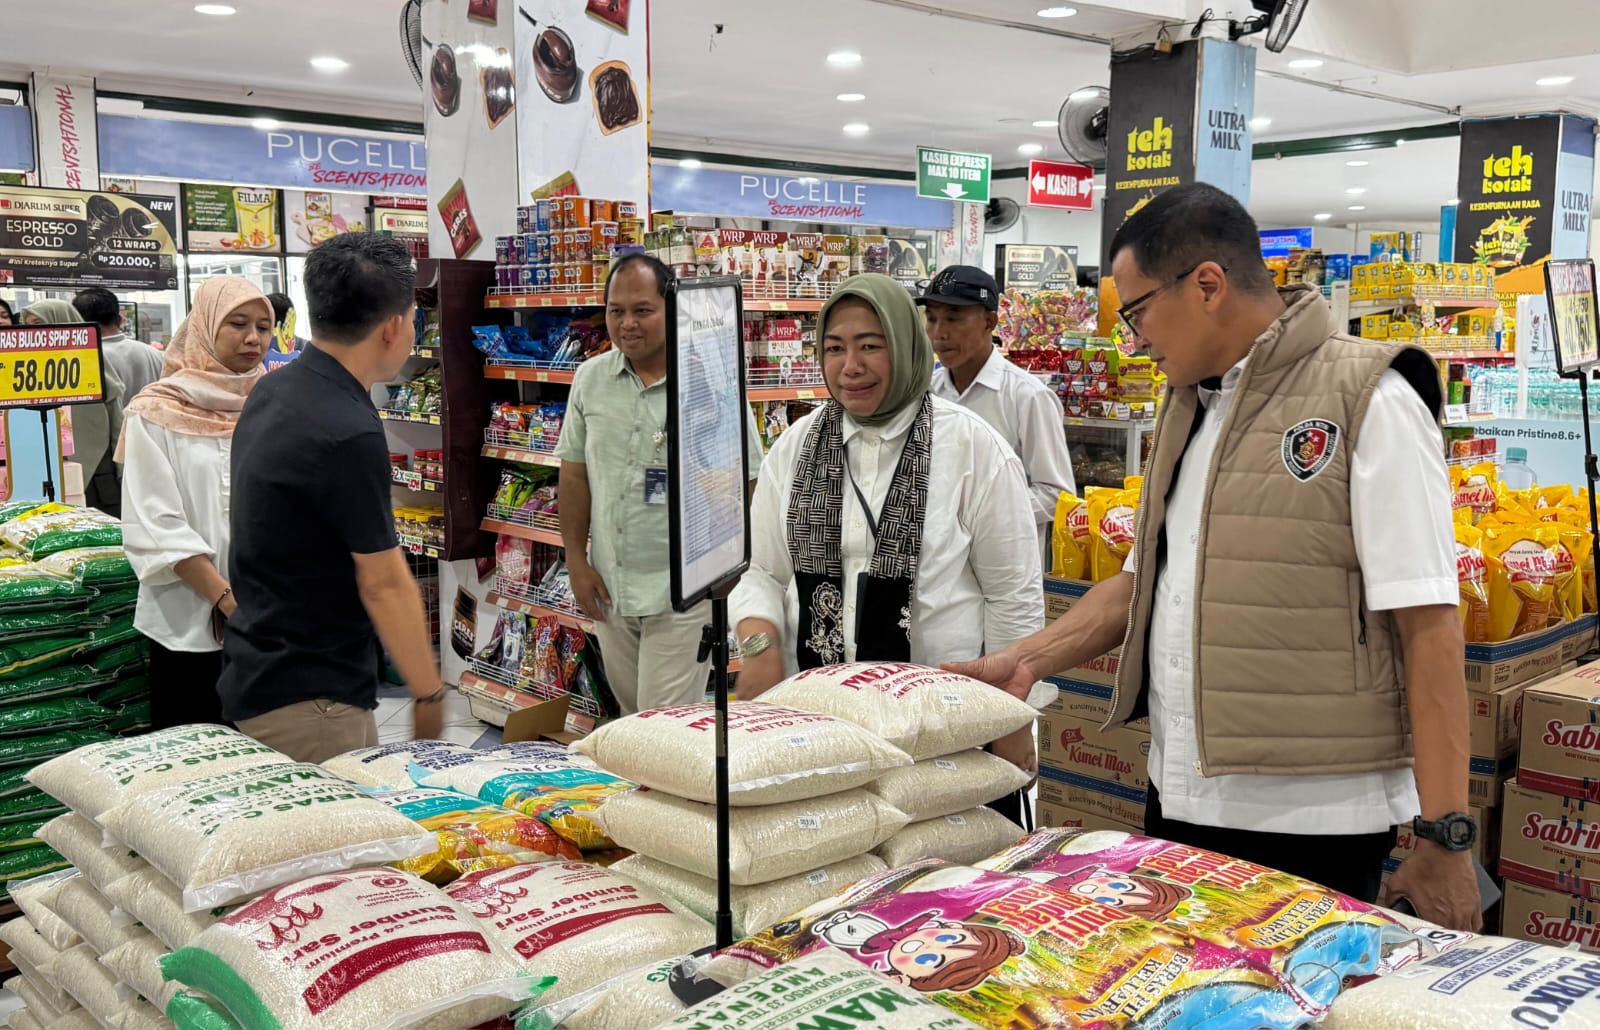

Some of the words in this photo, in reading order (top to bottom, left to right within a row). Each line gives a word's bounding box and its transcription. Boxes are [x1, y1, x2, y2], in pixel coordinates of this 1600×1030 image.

[1208, 110, 1246, 131] ULTRA
[1127, 117, 1173, 153] teh
[1210, 131, 1241, 151] MILK
[922, 151, 949, 165] KASIR
[950, 155, 987, 169] EXPRESS
[1127, 151, 1172, 171] kotak
[1483, 145, 1533, 178] teh
[313, 169, 427, 187] SCENTSATION
[927, 165, 947, 178] MAX
[948, 166, 959, 178] 10
[960, 169, 981, 181] ITEM
[740, 175, 867, 205] PUCELLE
[1047, 174, 1077, 197] KASIR
[1482, 176, 1532, 194] kotak
[150, 201, 174, 211] NEW
[238, 192, 270, 204] FILMA
[1521, 199, 1541, 209] RASA
[1562, 190, 1589, 212] ULTRA
[770, 204, 864, 217] SCENTSATIONAL
[6, 219, 77, 235] ESPRESSO
[1562, 212, 1585, 232] MILK
[21, 235, 64, 248] GOLD
[113, 240, 121, 249] 12
[123, 240, 157, 250] WRAPS
[722, 230, 745, 243] WRP
[753, 232, 778, 244] WRP
[796, 236, 816, 246] WRP
[826, 242, 843, 251] WRP
[18, 330, 46, 347] BULOG
[49, 330, 70, 346] SPHP
[72, 329, 88, 345] 5KG
[776, 327, 795, 336] WRP
[12, 357, 80, 392] 58.000
[1517, 428, 1582, 441] Pristine8.6+
[893, 677, 935, 699] NETTO
[745, 720, 794, 734] NETTO
[1069, 745, 1103, 767] Kunci
[1104, 753, 1135, 774] Mas
[189, 772, 323, 806] MAWAR
[551, 885, 636, 909] Sumber
[599, 894, 639, 904] Beras
[1304, 895, 1337, 916] BERAS
[348, 905, 456, 935] Sumber
[408, 914, 458, 925] Beras
[495, 908, 545, 931] Sari
[514, 908, 578, 932] Premium
[1000, 892, 1099, 933] andan
[1044, 904, 1135, 946] Putri
[282, 934, 341, 968] Sari
[303, 932, 381, 971] Premium
[734, 965, 798, 994] NETTO
[1140, 953, 1190, 995] BERAS
[782, 974, 844, 1005] SUDARSO
[766, 998, 783, 1010] 33
[734, 1004, 769, 1026] TELP
